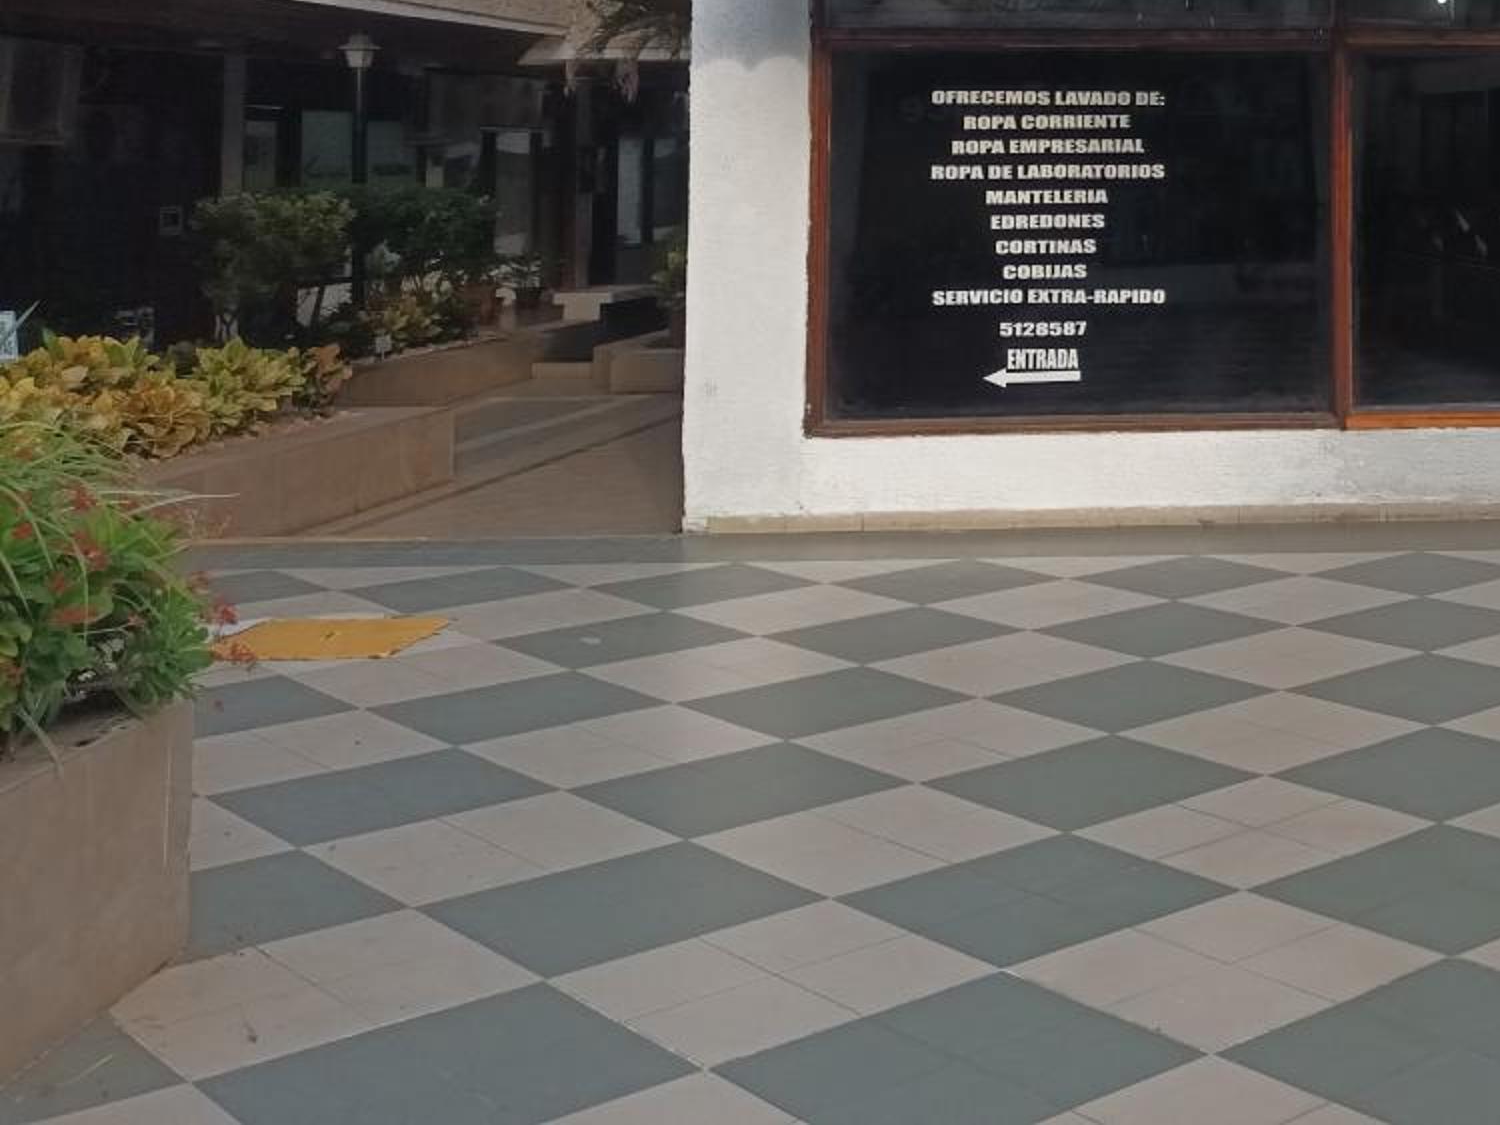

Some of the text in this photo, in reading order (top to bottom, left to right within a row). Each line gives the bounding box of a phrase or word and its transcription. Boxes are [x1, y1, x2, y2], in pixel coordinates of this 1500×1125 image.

[931, 90, 1165, 106] OFRECEMOS LAVADO DE:
[963, 114, 1131, 130] ROPA CORRIENTE
[951, 138, 1145, 155] ROPA EMPRESARIAL
[930, 164, 1166, 180] ROPA DE LABORATORIOS
[985, 189, 1109, 205] MANTELERIA
[990, 214, 1106, 230] EDREDONES
[995, 238, 1097, 255] CORTINAS
[1002, 263, 1088, 280] COBIJAS
[931, 289, 1167, 305] SERVICIO EXTRA-RAPIDO
[999, 321, 1088, 337] 5128587
[1006, 347, 1080, 370] ENTRADA
